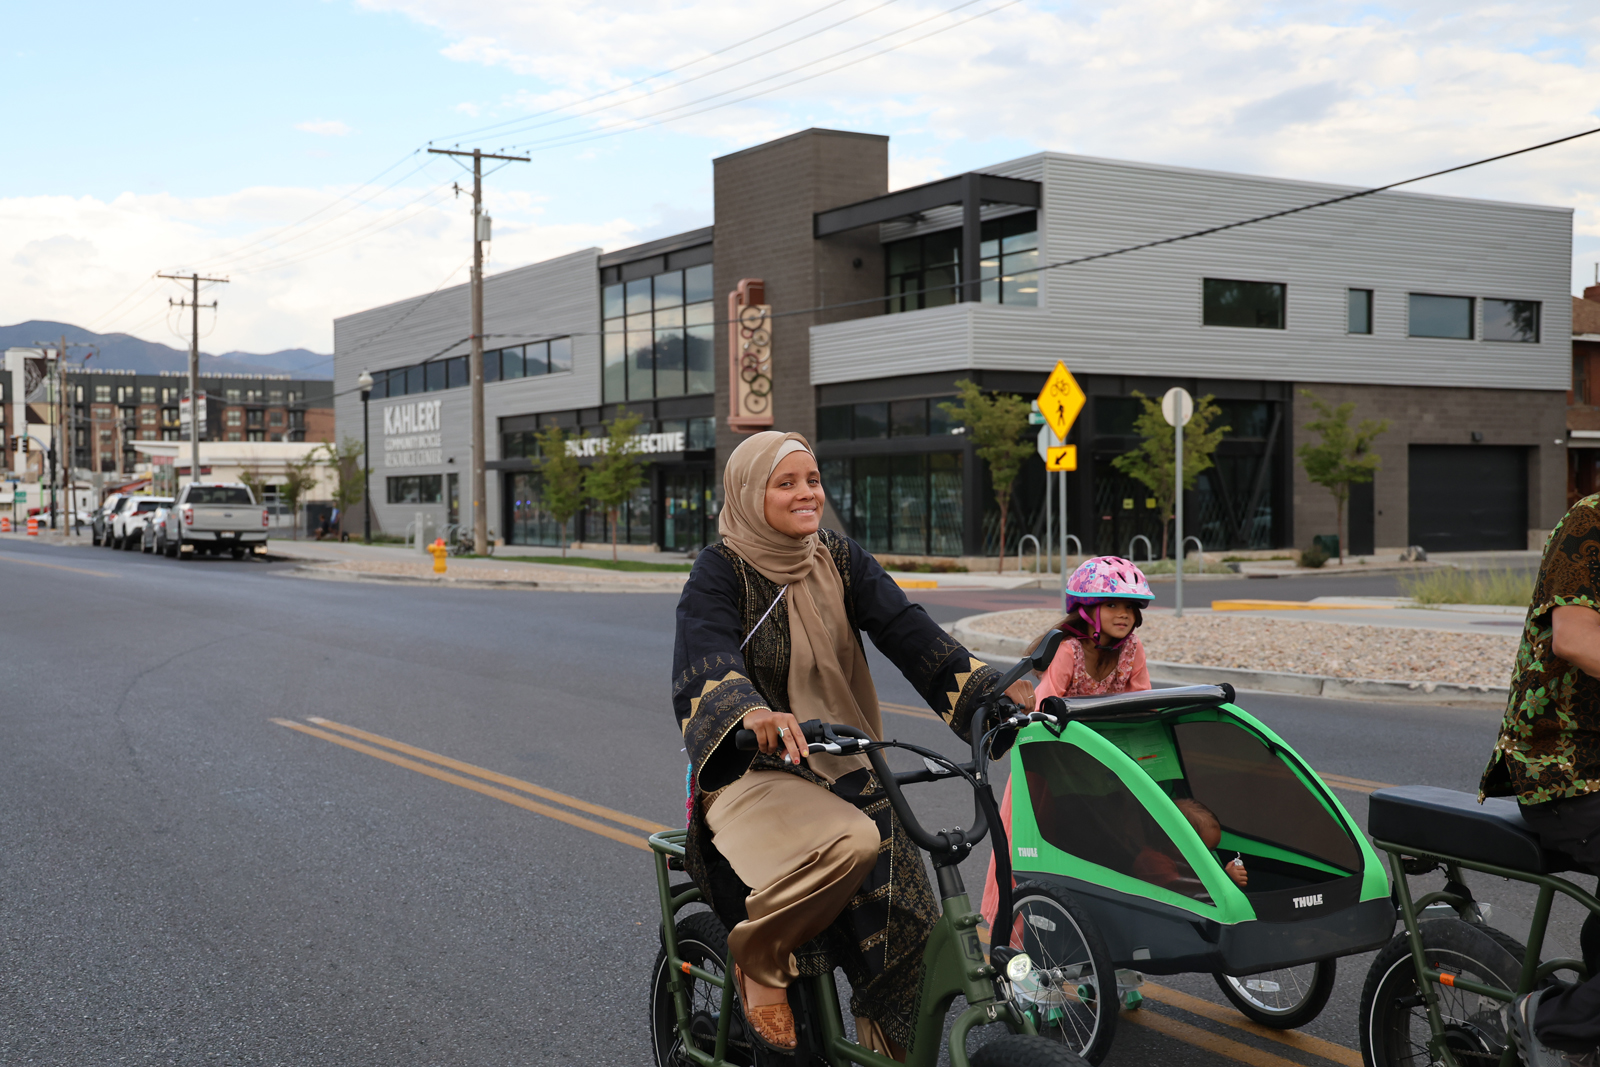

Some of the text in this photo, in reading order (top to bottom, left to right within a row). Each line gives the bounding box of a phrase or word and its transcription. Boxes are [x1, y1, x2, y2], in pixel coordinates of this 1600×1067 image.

[384, 400, 441, 435] KAHLERT
[612, 431, 686, 455] LECTIVE
[1017, 847, 1038, 858] THULE
[1292, 893, 1323, 908] THULE
[968, 935, 982, 954] R
[908, 963, 927, 1055] RAD POWER BIKES
